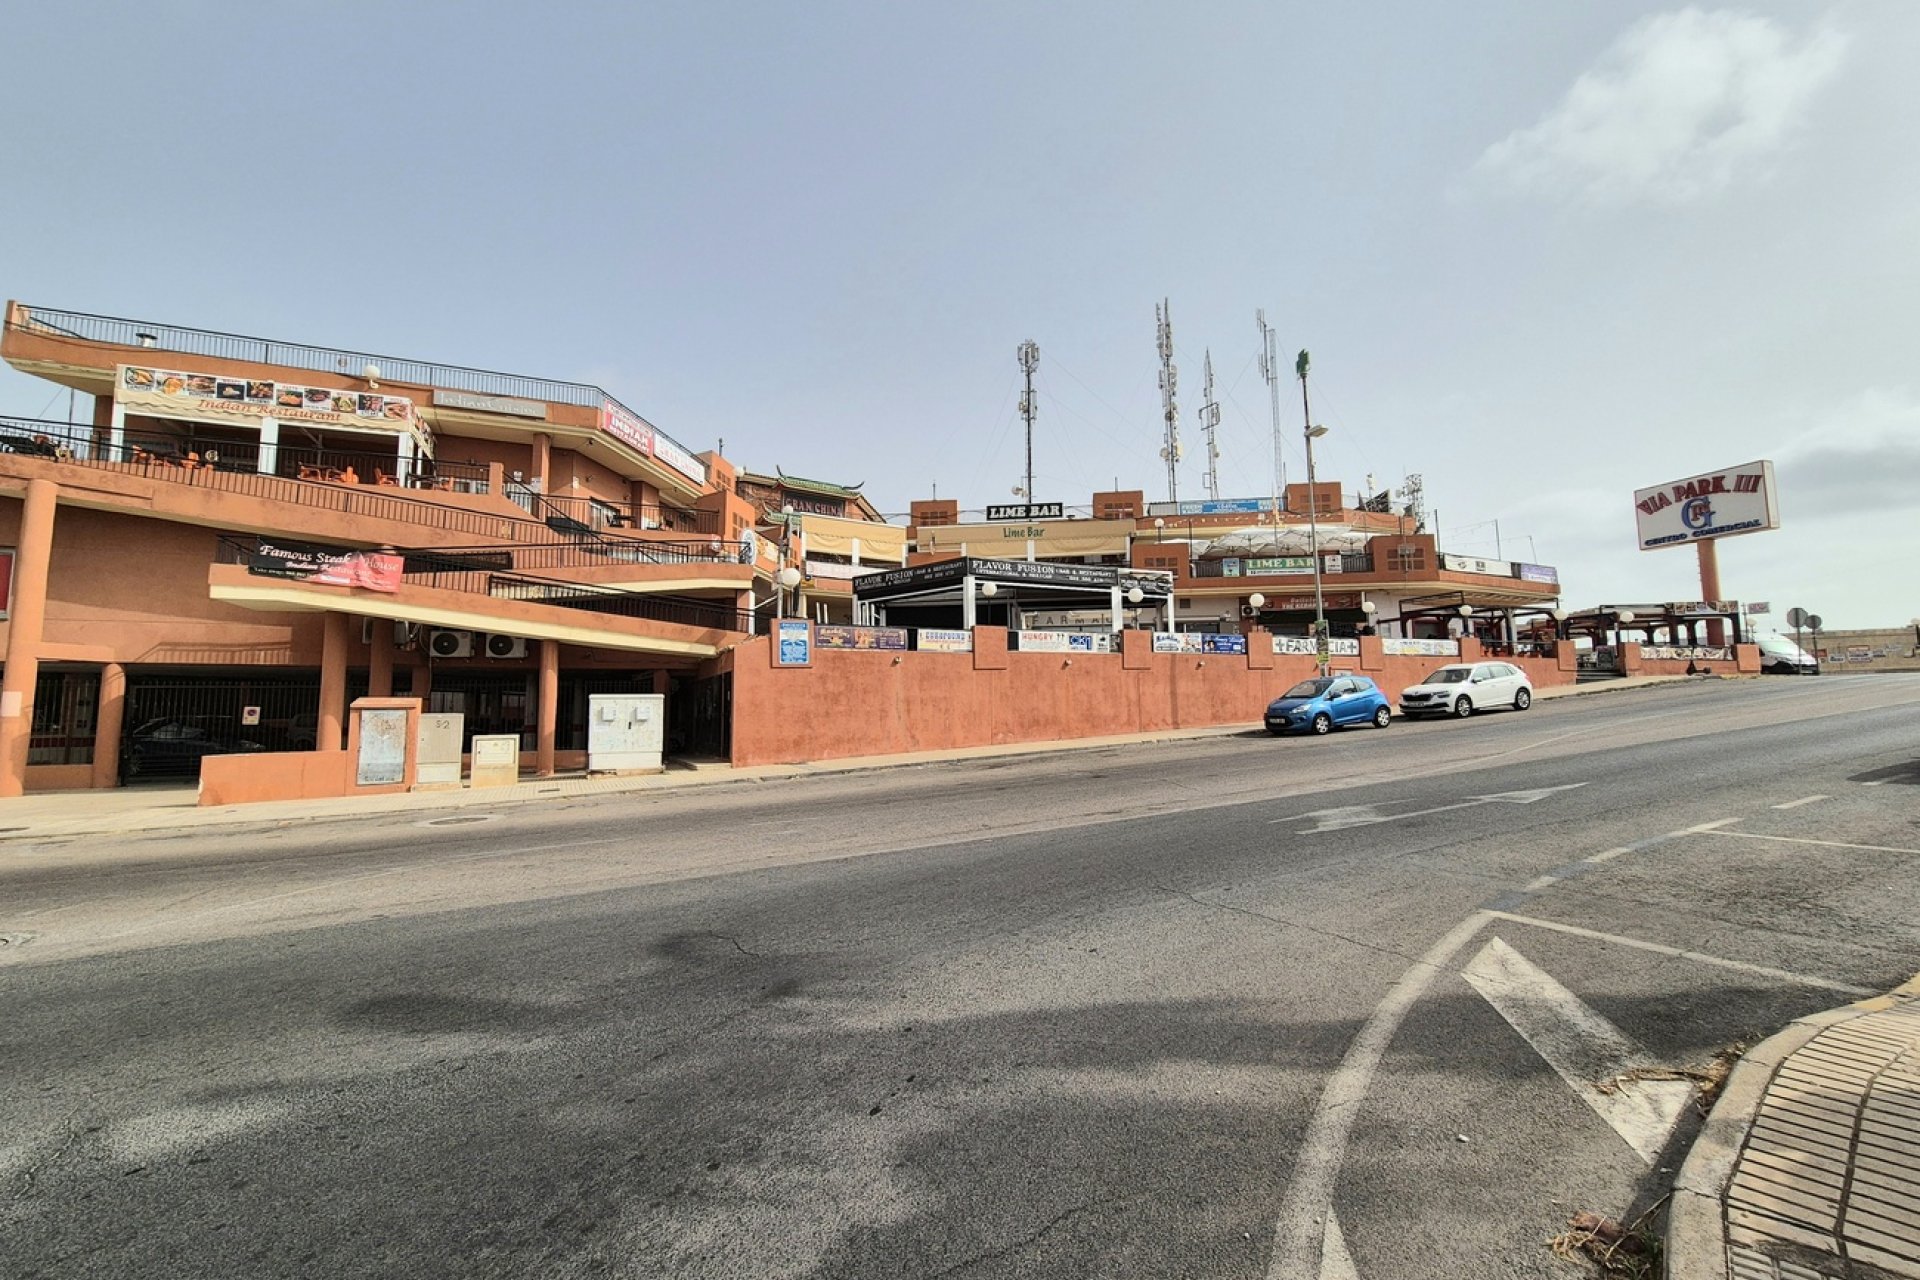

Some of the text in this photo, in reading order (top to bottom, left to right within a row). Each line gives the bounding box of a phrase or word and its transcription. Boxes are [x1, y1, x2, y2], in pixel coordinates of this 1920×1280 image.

[198, 399, 341, 421] Indian Restaurant
[611, 415, 649, 447] INDIAN
[1637, 474, 1763, 515] VIA PARK III
[785, 498, 842, 517] GRAN CHINA
[989, 505, 1060, 518] LIME BAR
[1003, 526, 1045, 538] Lime Bar
[1644, 518, 1762, 546] CENTRO COMERCIAL
[259, 545, 399, 571] Famous Steak House
[972, 560, 1012, 571] FLAVOR
[1017, 562, 1055, 574] FUSION
[1248, 559, 1283, 569] LIME
[1286, 559, 1315, 568] BAR
[855, 575, 883, 588] FLAVOR
[886, 570, 914, 581] FUSION
[1022, 633, 1048, 641] HUNGRY
[1286, 639, 1347, 653] FARMCIA
